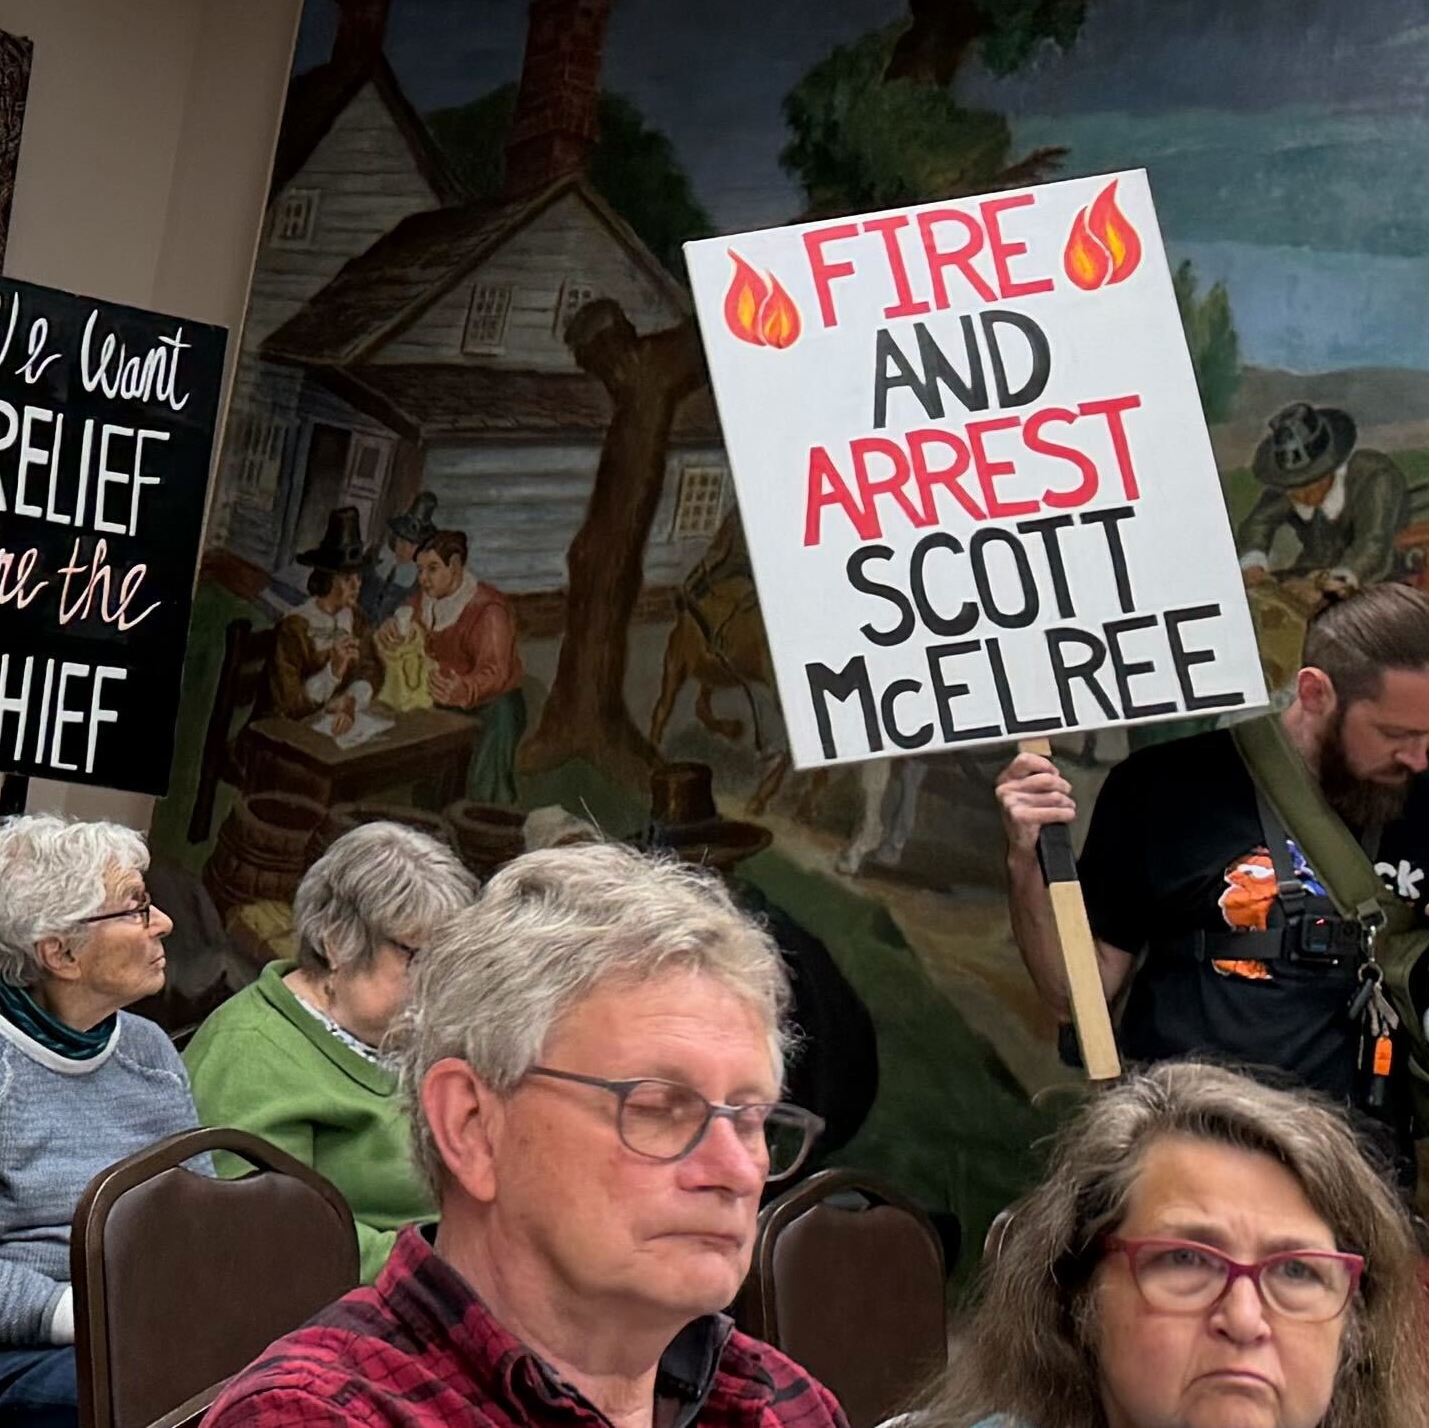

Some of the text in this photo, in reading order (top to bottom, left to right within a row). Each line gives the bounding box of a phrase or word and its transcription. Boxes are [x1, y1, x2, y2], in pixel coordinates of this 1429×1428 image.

[801, 193, 1056, 328] FIRE
[872, 309, 1051, 429] AND
[803, 393, 1142, 548] ARREST
[57, 537, 162, 632] the
[845, 504, 1137, 647] SCOTT
[804, 603, 1245, 760] McELREE
